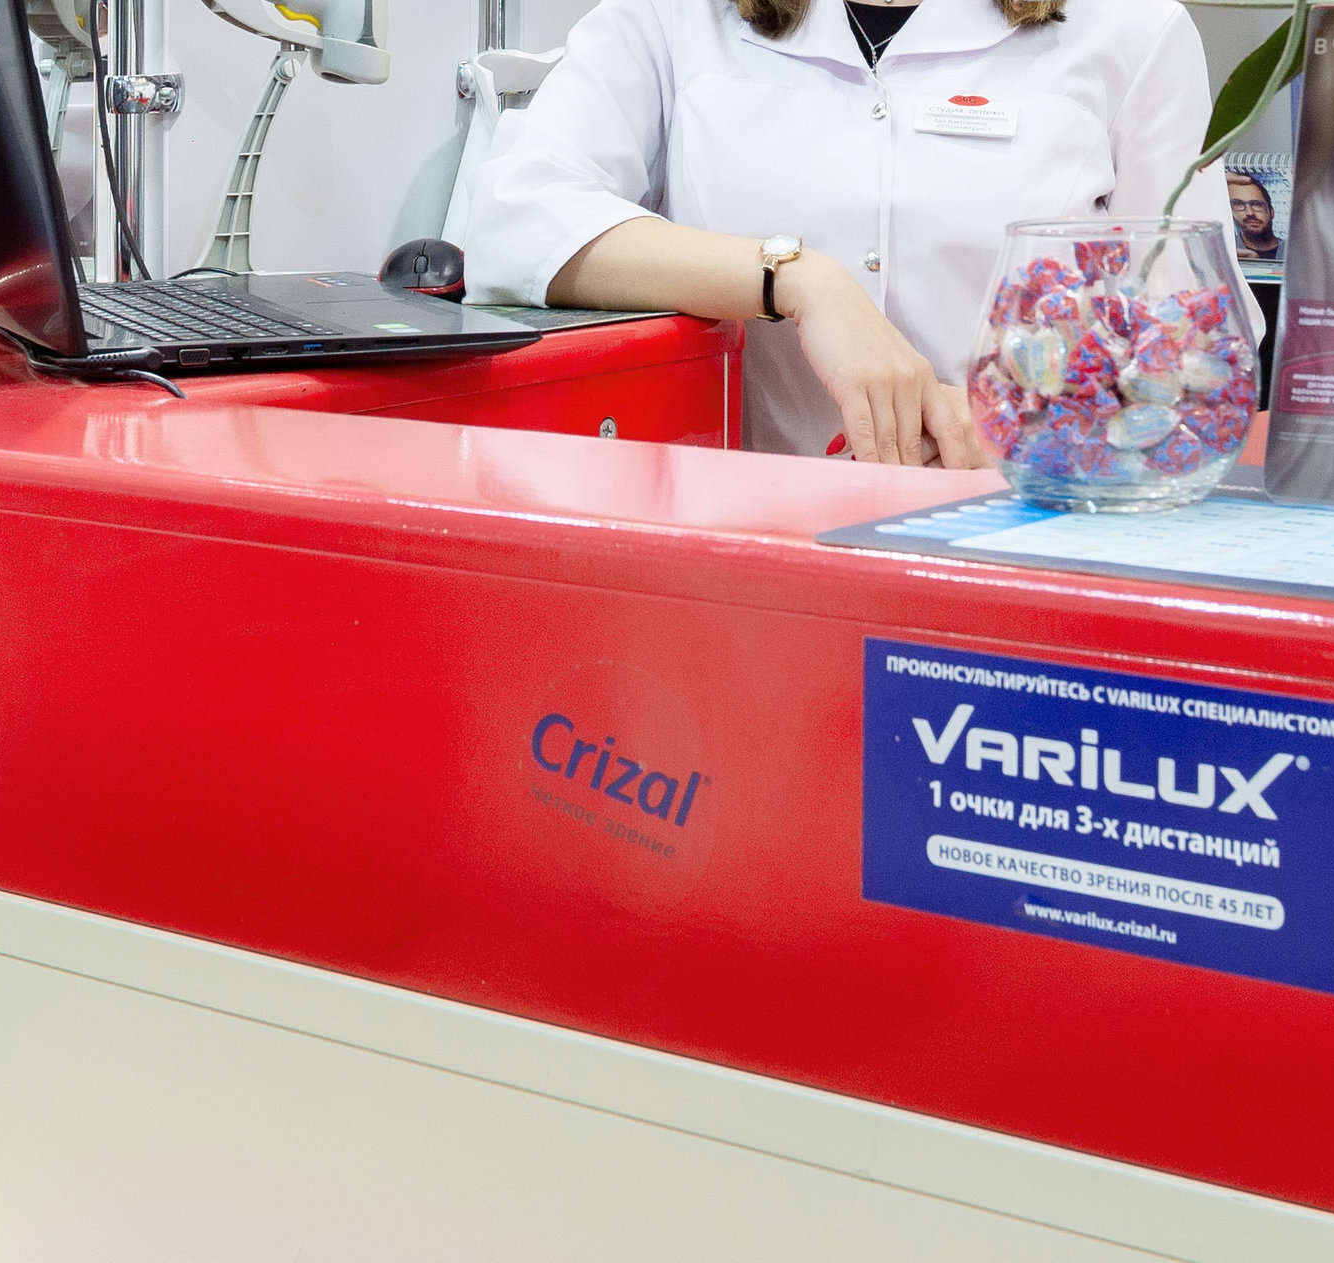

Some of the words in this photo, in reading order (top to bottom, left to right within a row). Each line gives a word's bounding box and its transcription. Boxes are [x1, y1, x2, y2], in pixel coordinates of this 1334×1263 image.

[1314, 38, 1327, 54] В
[886, 656, 1092, 704] ПРОКОНСУЛЬТИРУЙТЕСЬ
[1093, 687, 1105, 703] С
[1106, 689, 1181, 714] VARILUX
[531, 713, 701, 827] Crizal
[529, 783, 597, 827] Четкое
[603, 818, 676, 859] зрение
[929, 780, 942, 808] 1
[949, 790, 1014, 821] очки
[1019, 803, 1070, 831] для
[1075, 805, 1119, 840] 3-х
[1123, 821, 1280, 868] дистанций
[939, 844, 992, 868] НОВОЕ
[997, 854, 1082, 884] КАЧЕСТВО
[1086, 872, 1151, 897] ЗРЕНИЯ
[1155, 885, 1214, 909] ПОСЛЕ
[1218, 898, 1238, 914] 45
[1241, 902, 1274, 920] ЛЕТ
[1024, 902, 1177, 944] www.varilux.crizal.ru
